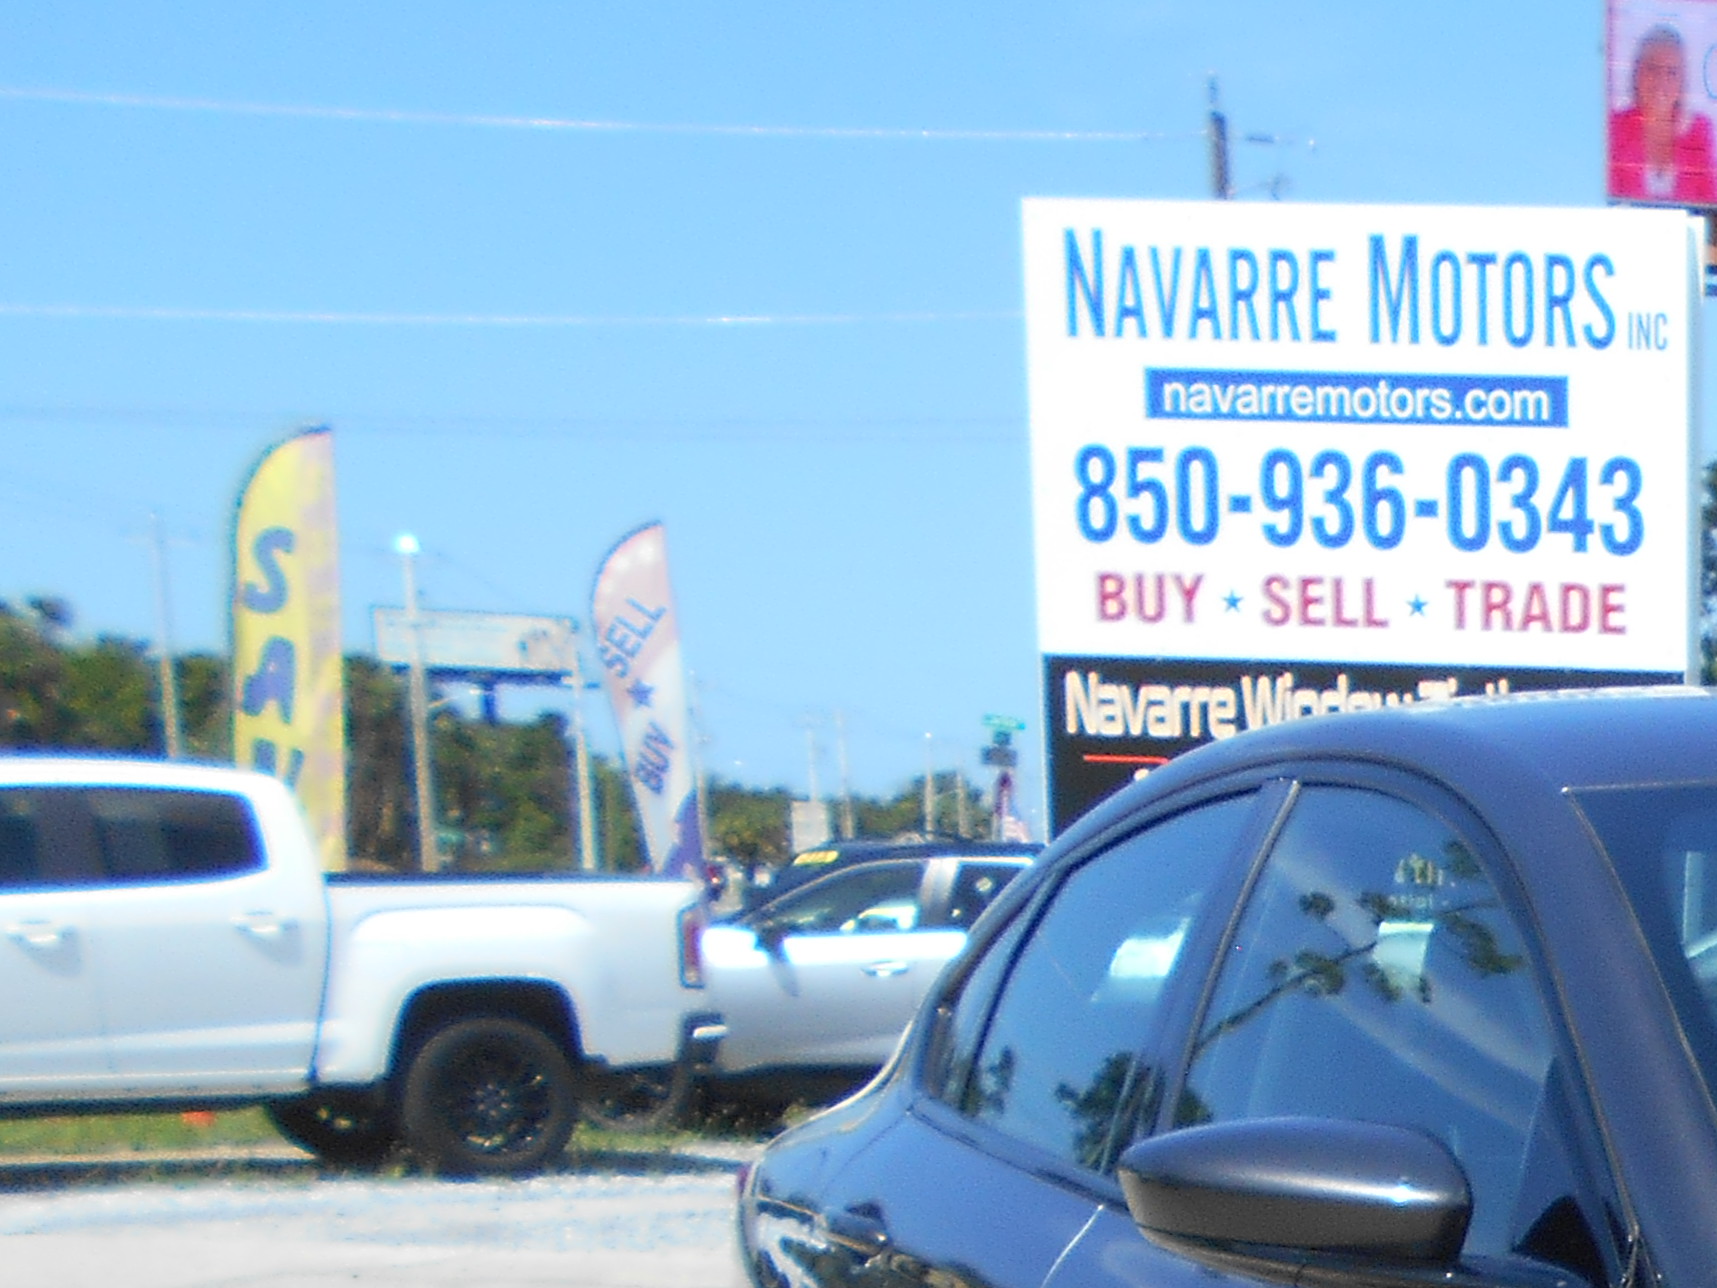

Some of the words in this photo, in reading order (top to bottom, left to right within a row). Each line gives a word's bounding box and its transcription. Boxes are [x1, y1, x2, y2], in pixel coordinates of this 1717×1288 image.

[1063, 227, 1338, 343] NAVARRE
[1368, 232, 1617, 350] MOTORS
[1627, 311, 1669, 351] INC
[1162, 377, 1551, 420] navarremotors.com
[1073, 442, 1646, 557] 850-936-0343
[599, 597, 668, 680] SELL
[1095, 571, 1205, 625] BUY
[1261, 574, 1391, 629] SELL
[1445, 578, 1628, 636] TRADE
[1065, 671, 1238, 740] Navarre
[634, 721, 676, 797] BUY
